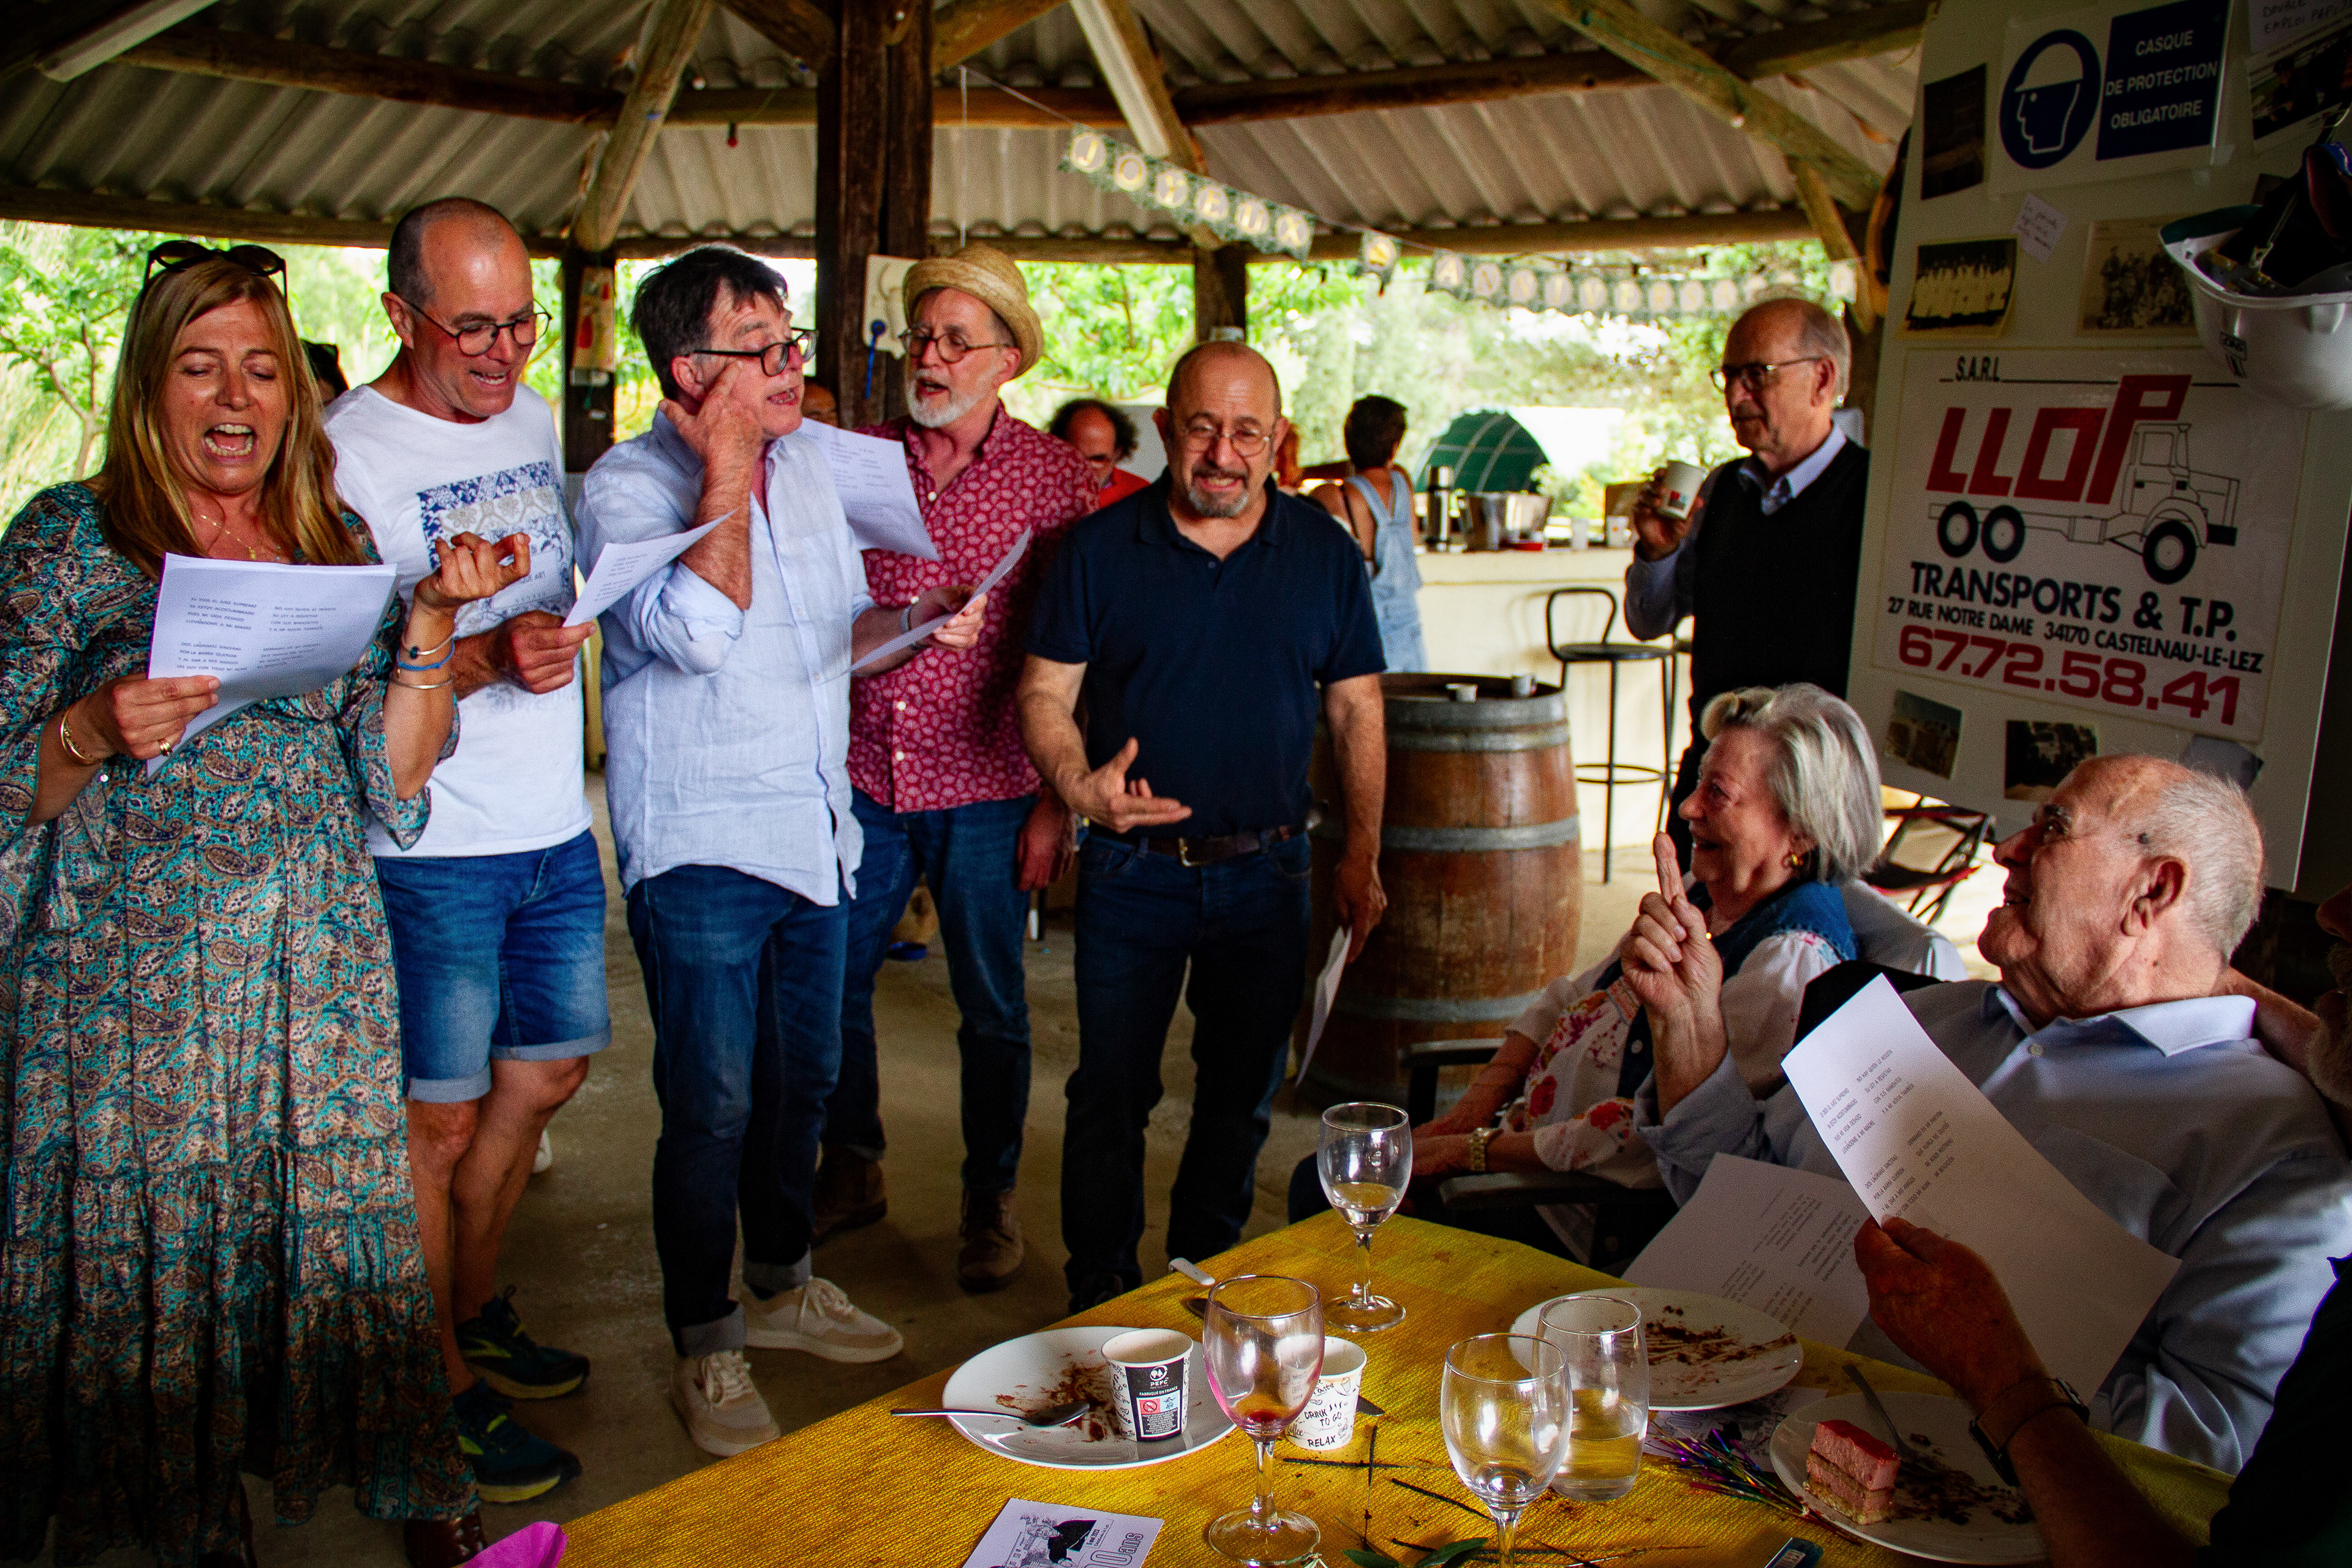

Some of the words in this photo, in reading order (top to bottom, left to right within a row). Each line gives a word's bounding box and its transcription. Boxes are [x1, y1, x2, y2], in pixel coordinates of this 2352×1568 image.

[2135, 29, 2195, 57] CASQUE
[2104, 78, 2125, 97] DE
[2127, 61, 2219, 92] PROTECTION
[2109, 99, 2204, 130] OBLIGATOIRE
[1076, 139, 1302, 247] JOYEUX
[1926, 375, 2192, 505] LLOP
[1910, 562, 2122, 624] TRANSPORTS
[2133, 592, 2162, 630] &
[2179, 596, 2237, 642] T.P.
[1888, 597, 1905, 613] 27
[1907, 600, 1933, 619] RUE
[1937, 605, 1986, 628] NOTRE
[1989, 614, 2034, 636] DAME
[2044, 622, 2089, 645] 34170
[2095, 630, 2264, 673] CASTELNAU-LE-LEZ
[1899, 625, 2241, 726] 67.72.58.41
[1305, 1409, 1328, 1420] DRINK
[1319, 1417, 1330, 1427] TO
[1332, 1412, 1342, 1422] GO
[1307, 1435, 1336, 1448] RELAX
